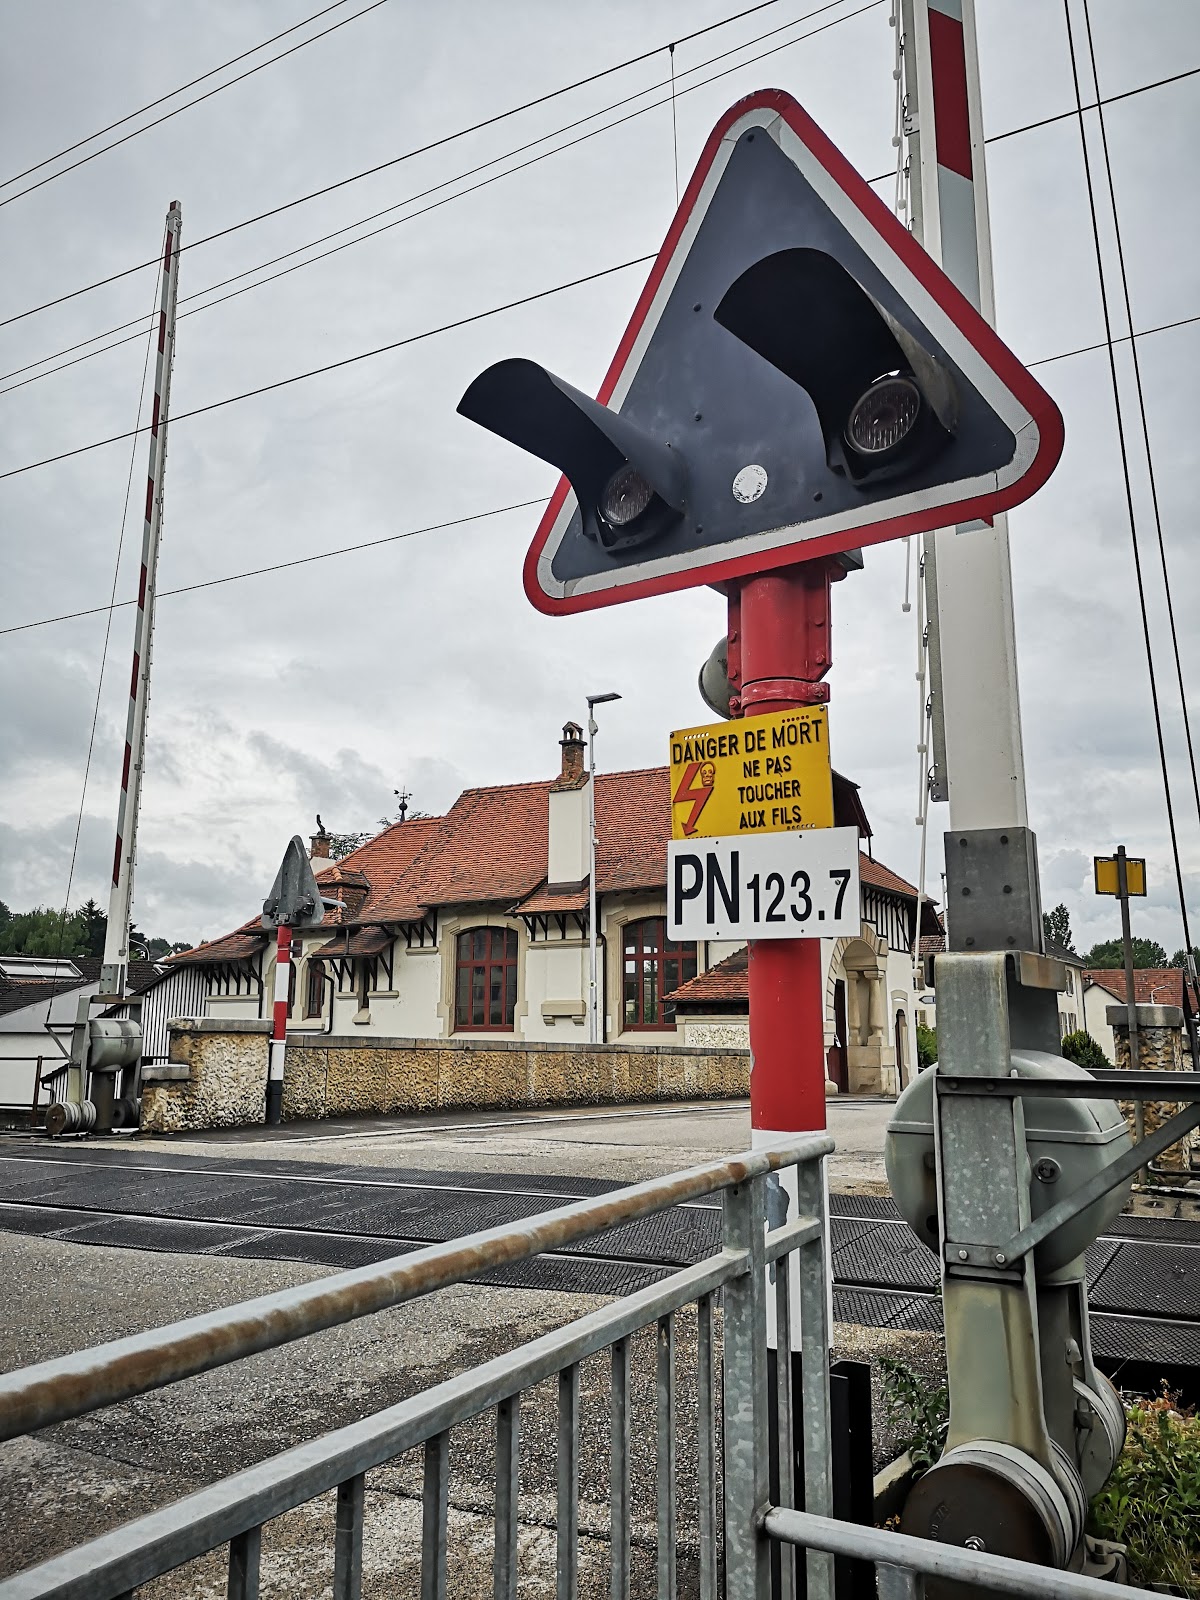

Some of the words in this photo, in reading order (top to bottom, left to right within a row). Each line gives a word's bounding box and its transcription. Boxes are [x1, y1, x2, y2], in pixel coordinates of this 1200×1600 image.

[673, 734, 740, 764] DANGER
[744, 729, 766, 753] DE
[772, 719, 822, 749] MORT
[743, 759, 760, 778] NE
[766, 755, 792, 775] PAS
[737, 780, 801, 804] TOUCHER
[739, 809, 766, 829] AUX
[772, 805, 802, 825] FILS
[674, 851, 739, 925] PN
[746, 869, 851, 923] 123.7
